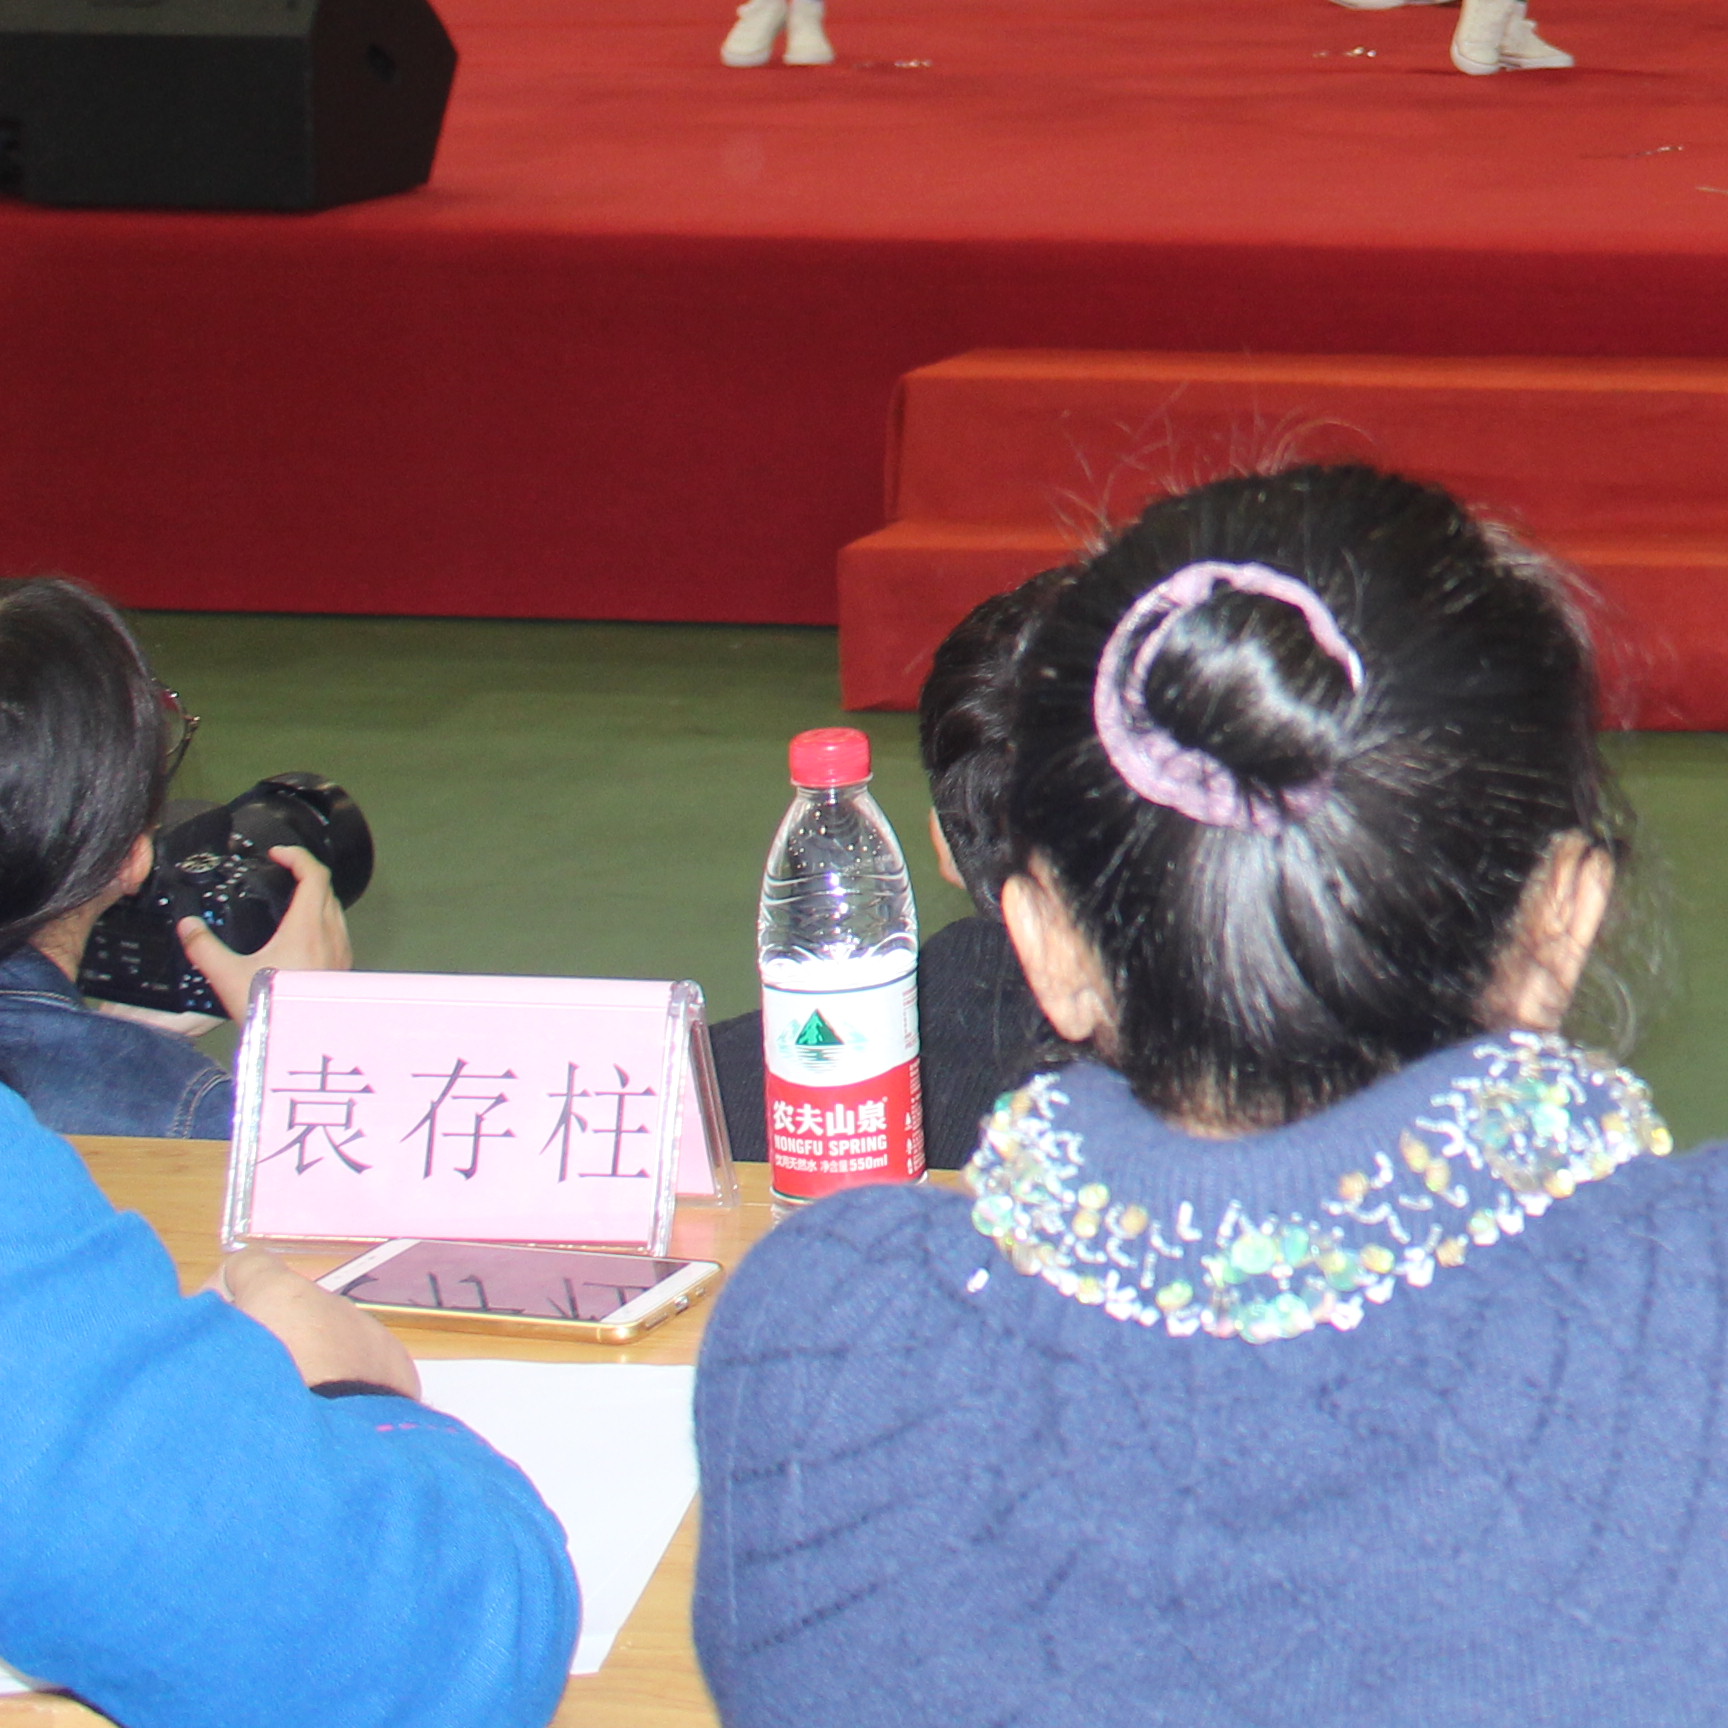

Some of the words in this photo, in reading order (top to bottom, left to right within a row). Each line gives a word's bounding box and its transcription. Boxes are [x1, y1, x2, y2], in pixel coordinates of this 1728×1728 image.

[254, 1053, 661, 1186] 袁存柱
[772, 1098, 888, 1137] 农夫山泉
[774, 1133, 824, 1156] NONGFU
[828, 1133, 888, 1157] SPRING
